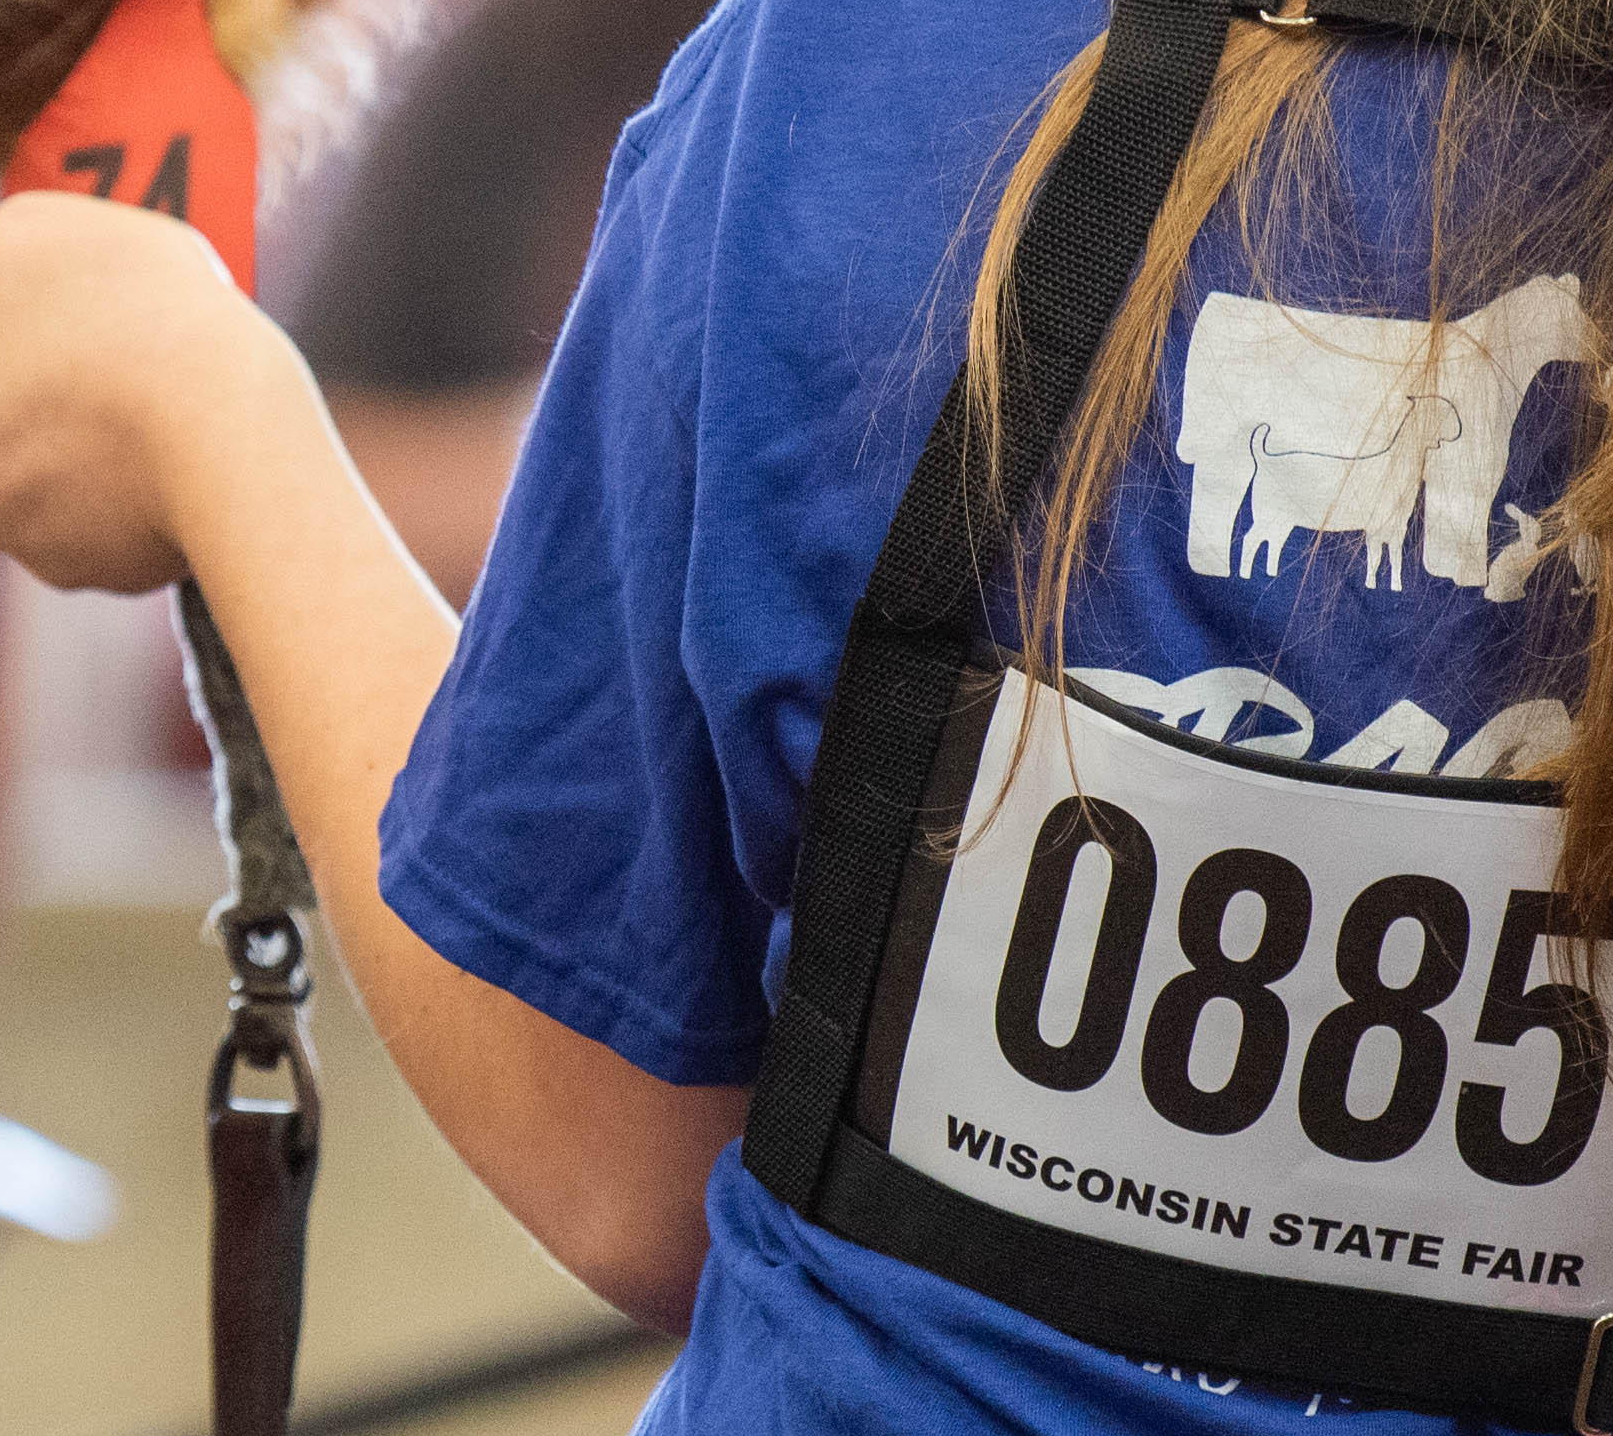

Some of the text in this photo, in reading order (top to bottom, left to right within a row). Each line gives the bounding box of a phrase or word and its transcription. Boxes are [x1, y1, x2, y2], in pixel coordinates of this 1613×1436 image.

[945, 1114, 1586, 1288] WISCONSIN STATE FAIR
